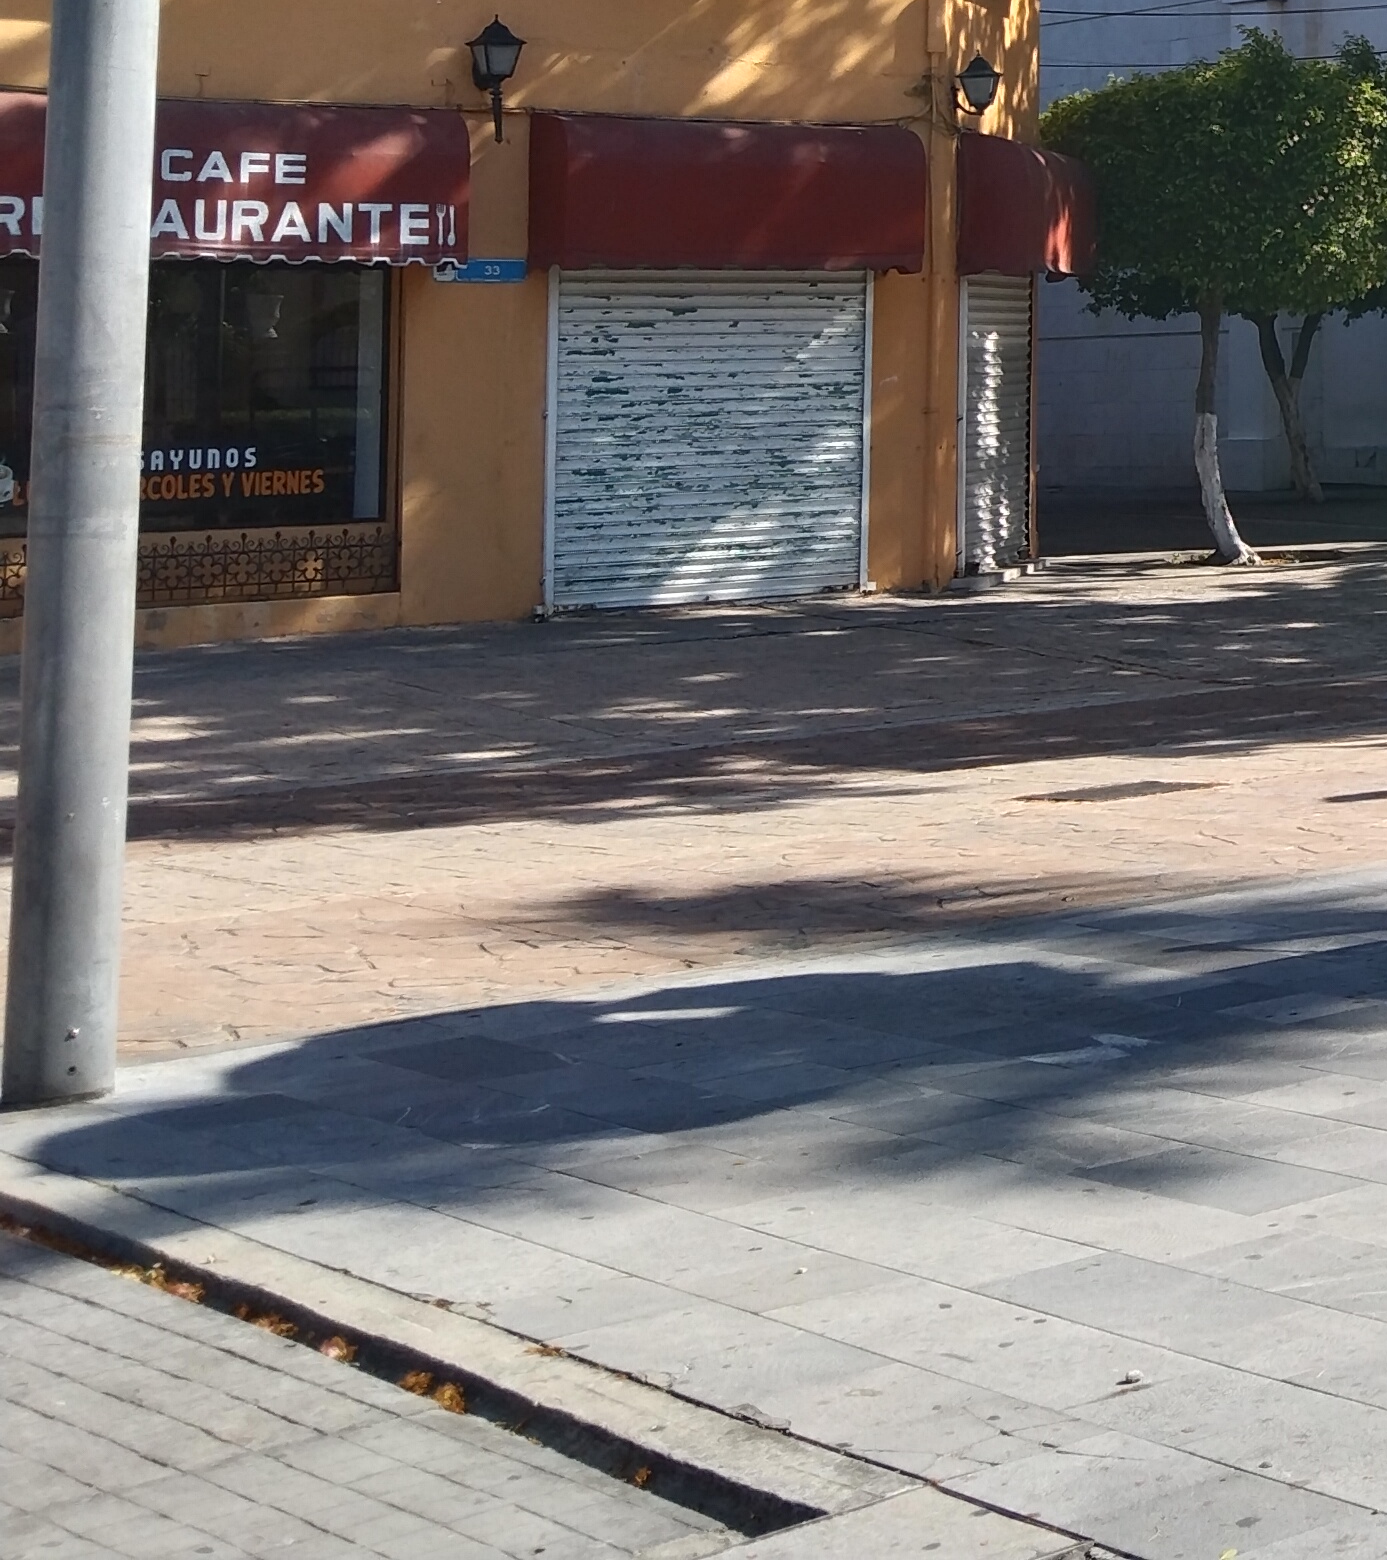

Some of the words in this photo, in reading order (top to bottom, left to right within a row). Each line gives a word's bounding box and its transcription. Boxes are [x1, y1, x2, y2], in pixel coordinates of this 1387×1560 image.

[161, 148, 307, 185] CAFE
[0, 195, 430, 246] RAURANTE
[484, 265, 501, 277] 33
[221, 472, 235, 498] Y
[242, 468, 326, 497] VIERNES
